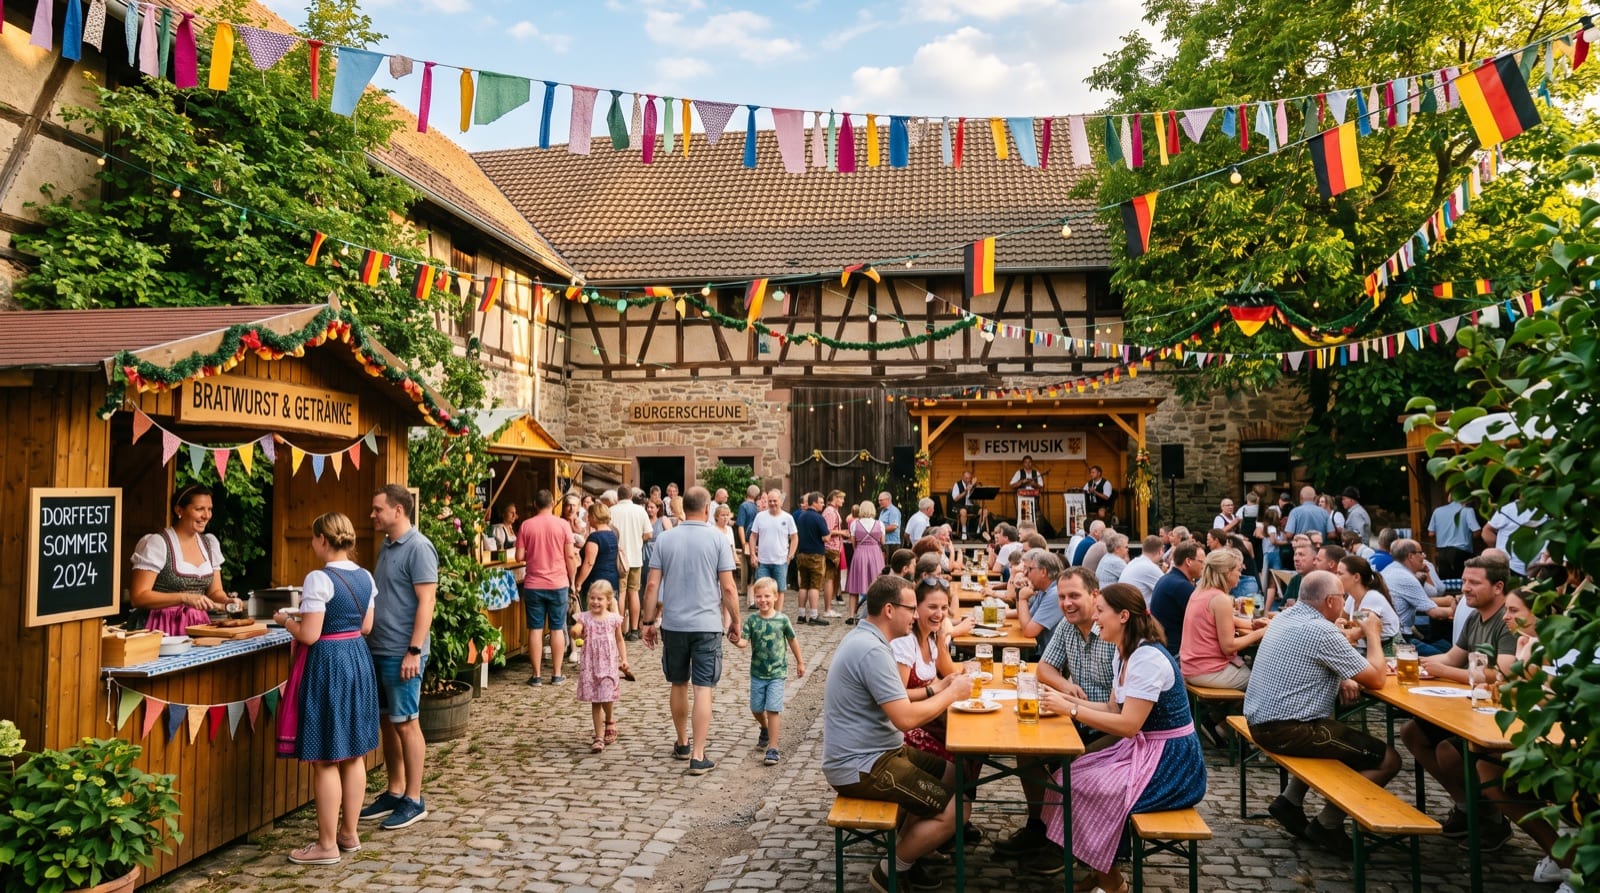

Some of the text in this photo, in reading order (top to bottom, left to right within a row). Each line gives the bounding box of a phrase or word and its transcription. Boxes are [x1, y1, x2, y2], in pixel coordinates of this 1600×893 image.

[193, 381, 352, 425] BRATWURST & GETRÄNKE
[634, 403, 741, 419] BÜRGERSCHEUNE
[984, 439, 1064, 453] FESTMUSIK
[42, 505, 111, 526] DORFFEST
[43, 532, 108, 557] SOMMER
[52, 561, 98, 589] 2024
